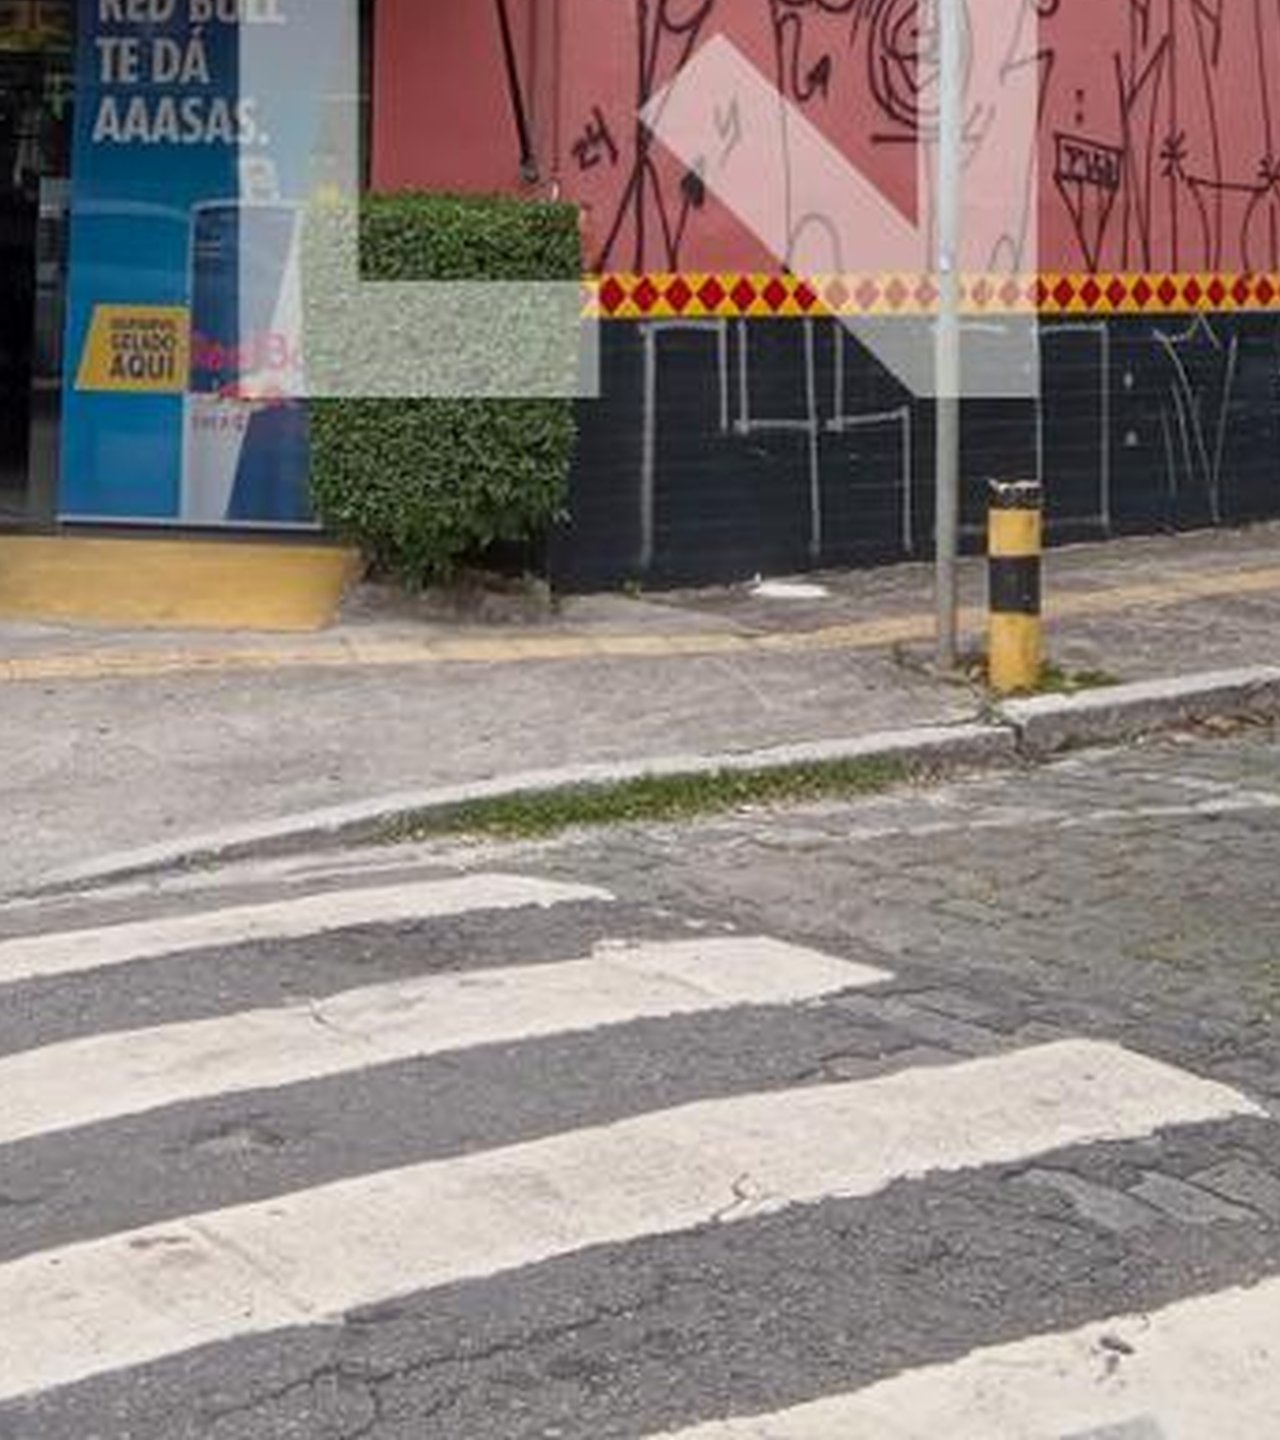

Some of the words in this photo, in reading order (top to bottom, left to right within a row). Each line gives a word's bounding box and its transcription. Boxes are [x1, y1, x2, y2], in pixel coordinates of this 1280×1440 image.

[95, 36, 140, 83] TE
[151, 25, 210, 84] DÁ
[92, 96, 270, 145] AAASAS.
[109, 354, 174, 380] AQUI
